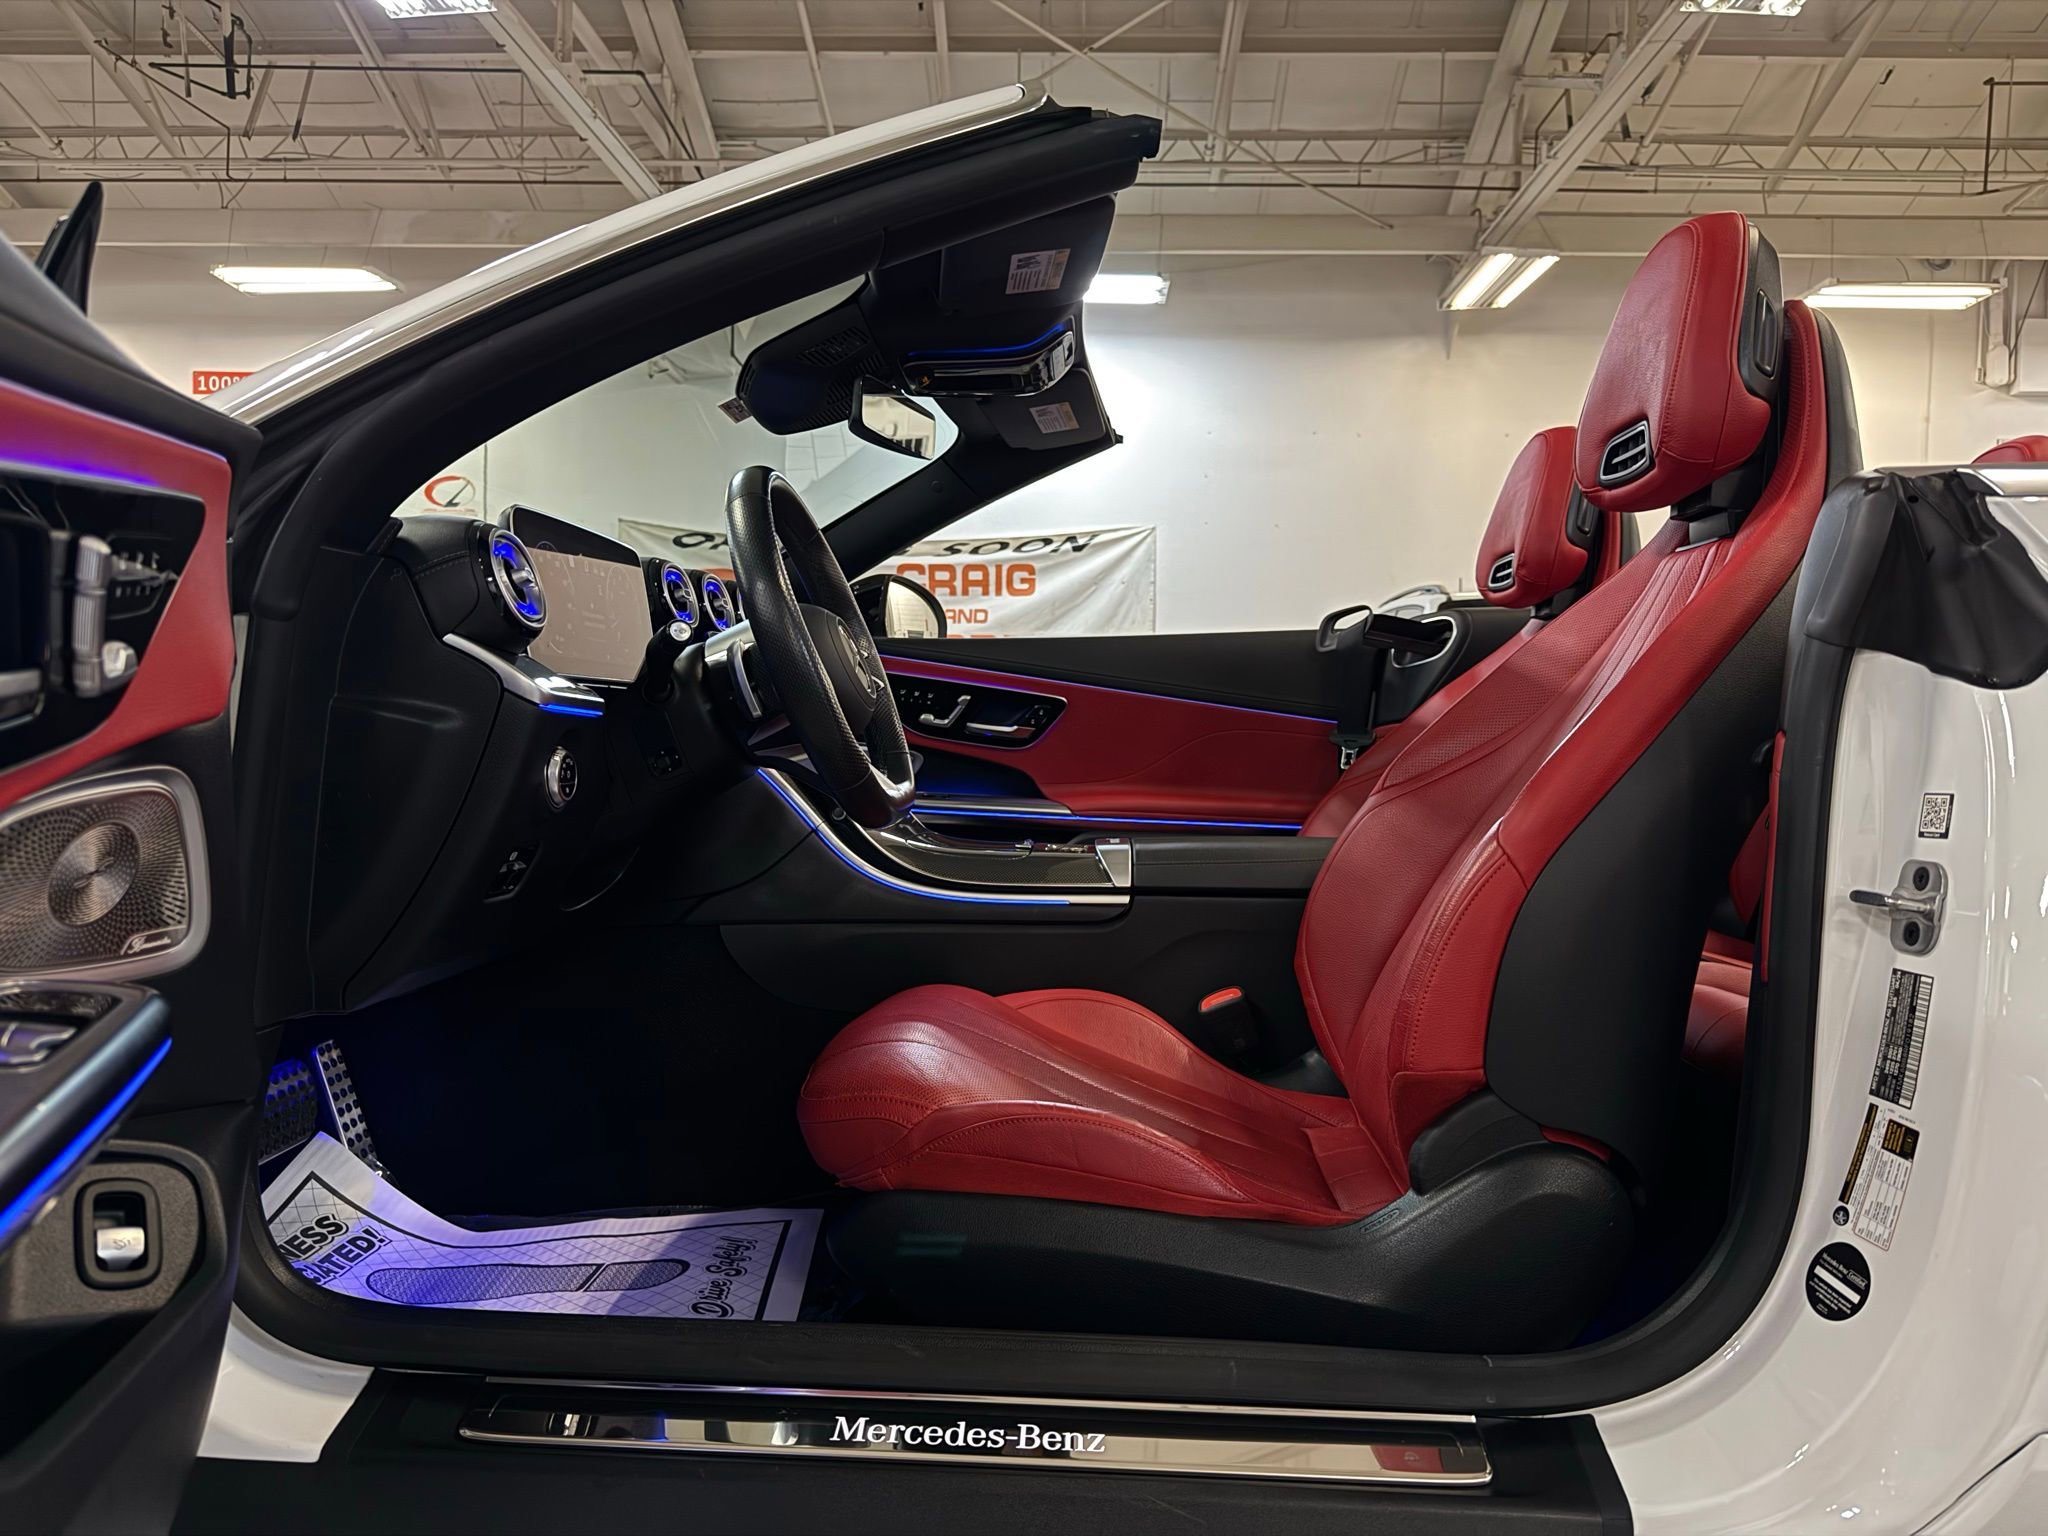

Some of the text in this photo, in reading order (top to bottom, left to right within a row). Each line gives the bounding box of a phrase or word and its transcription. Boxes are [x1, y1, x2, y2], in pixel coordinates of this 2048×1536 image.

[197, 375, 246, 391] 100
[936, 534, 1099, 557] SOON
[691, 1279, 734, 1318] Drive
[829, 1416, 1105, 1452] Mercedes-Benz
